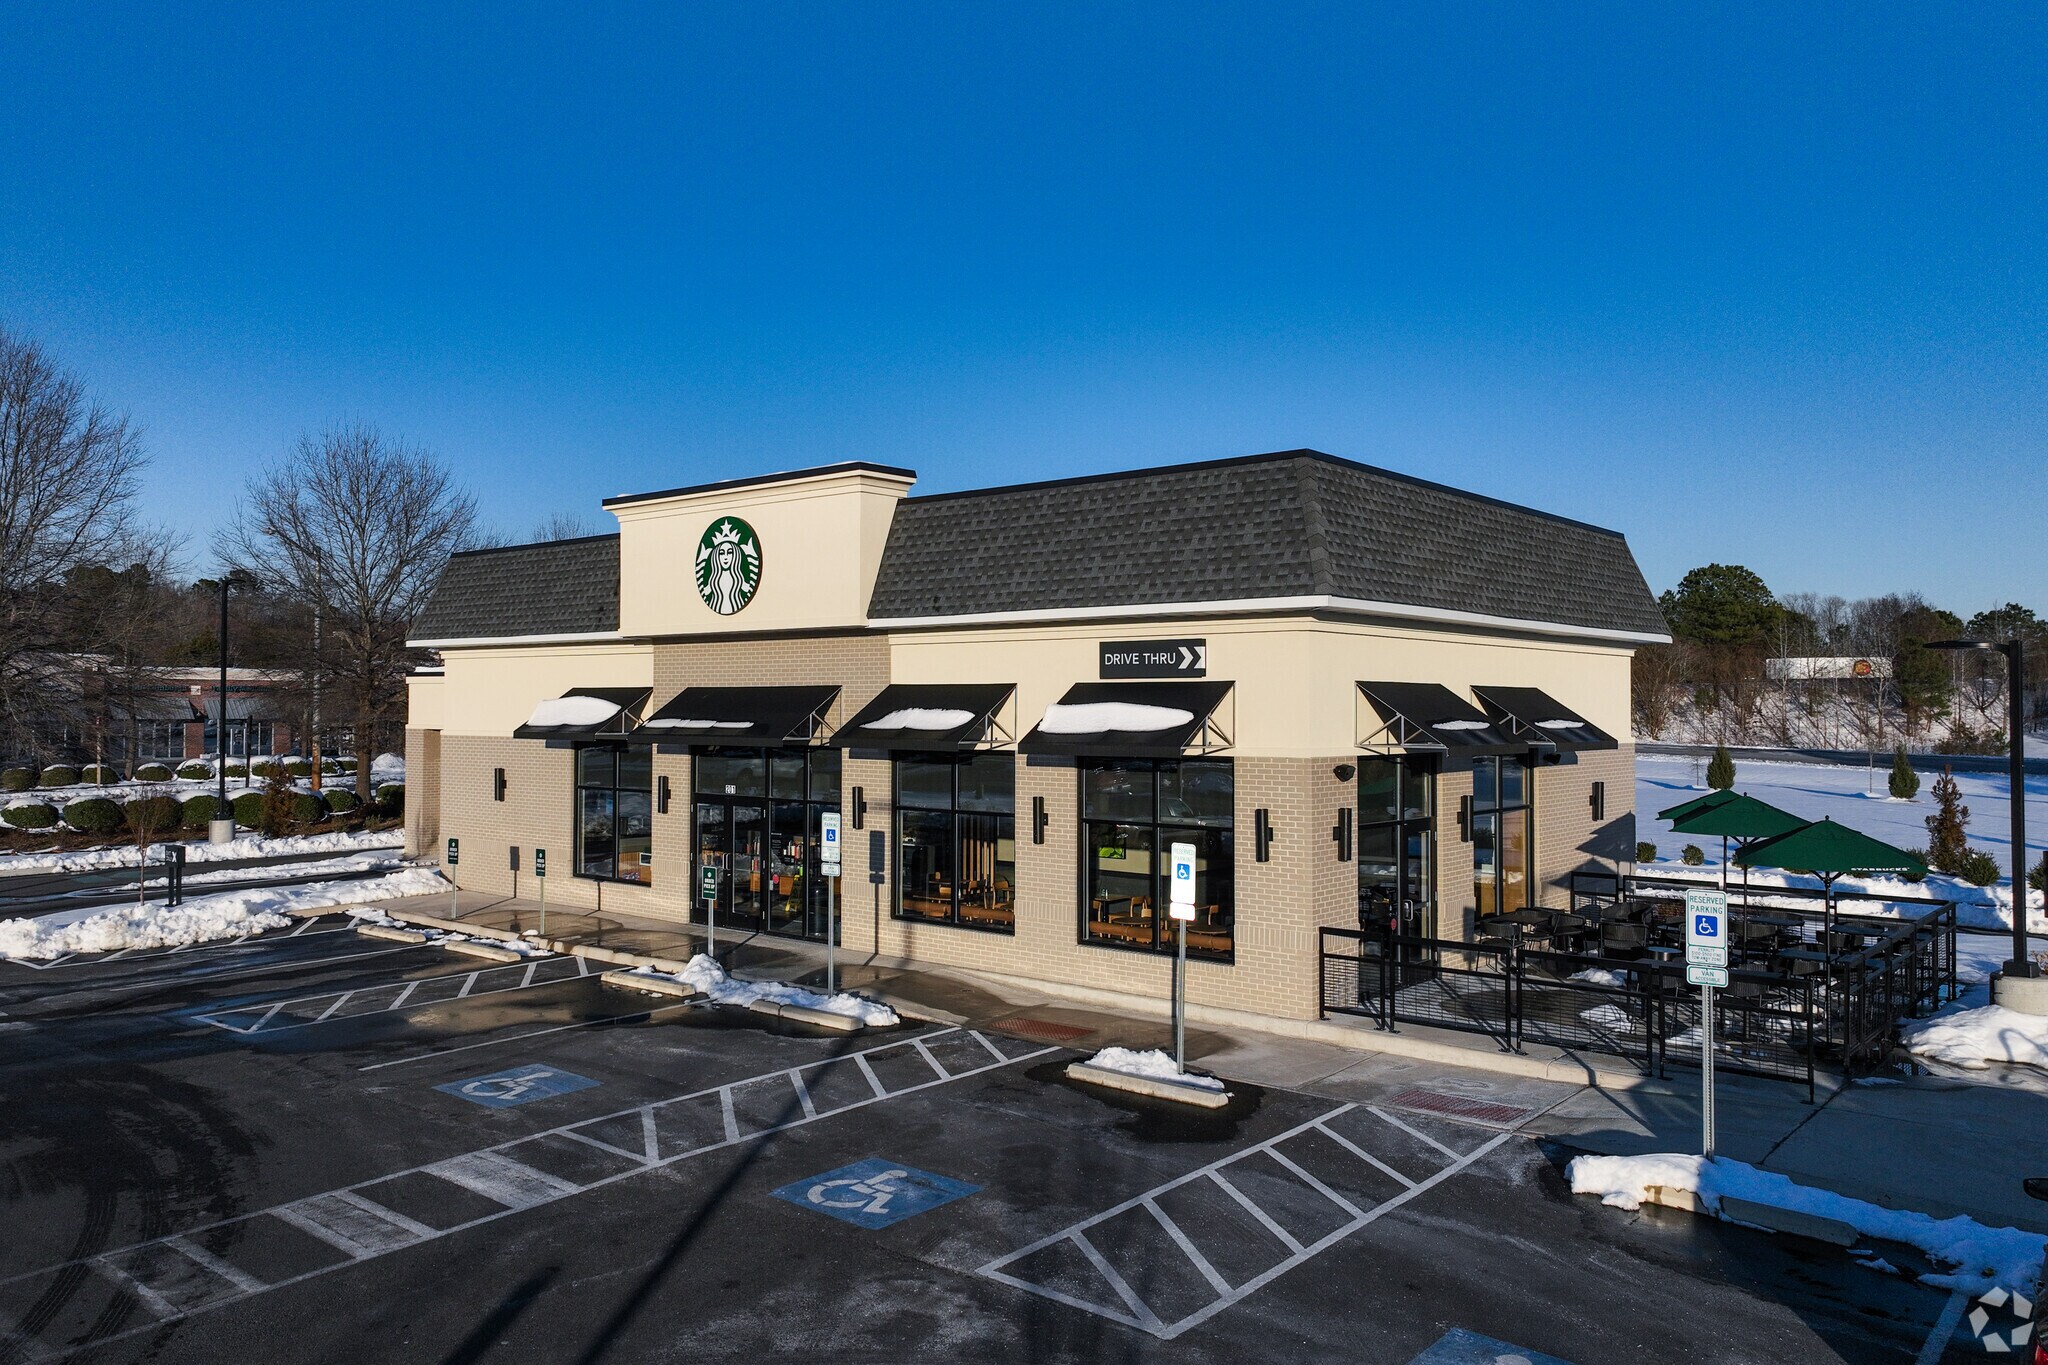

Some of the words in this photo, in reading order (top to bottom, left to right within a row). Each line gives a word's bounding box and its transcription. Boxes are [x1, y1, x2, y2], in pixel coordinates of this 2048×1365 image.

[1104, 653, 1140, 665] DRIVE
[1142, 652, 1176, 665] THRU
[1689, 895, 1724, 905] RESERVED
[1690, 904, 1723, 915] PARKING
